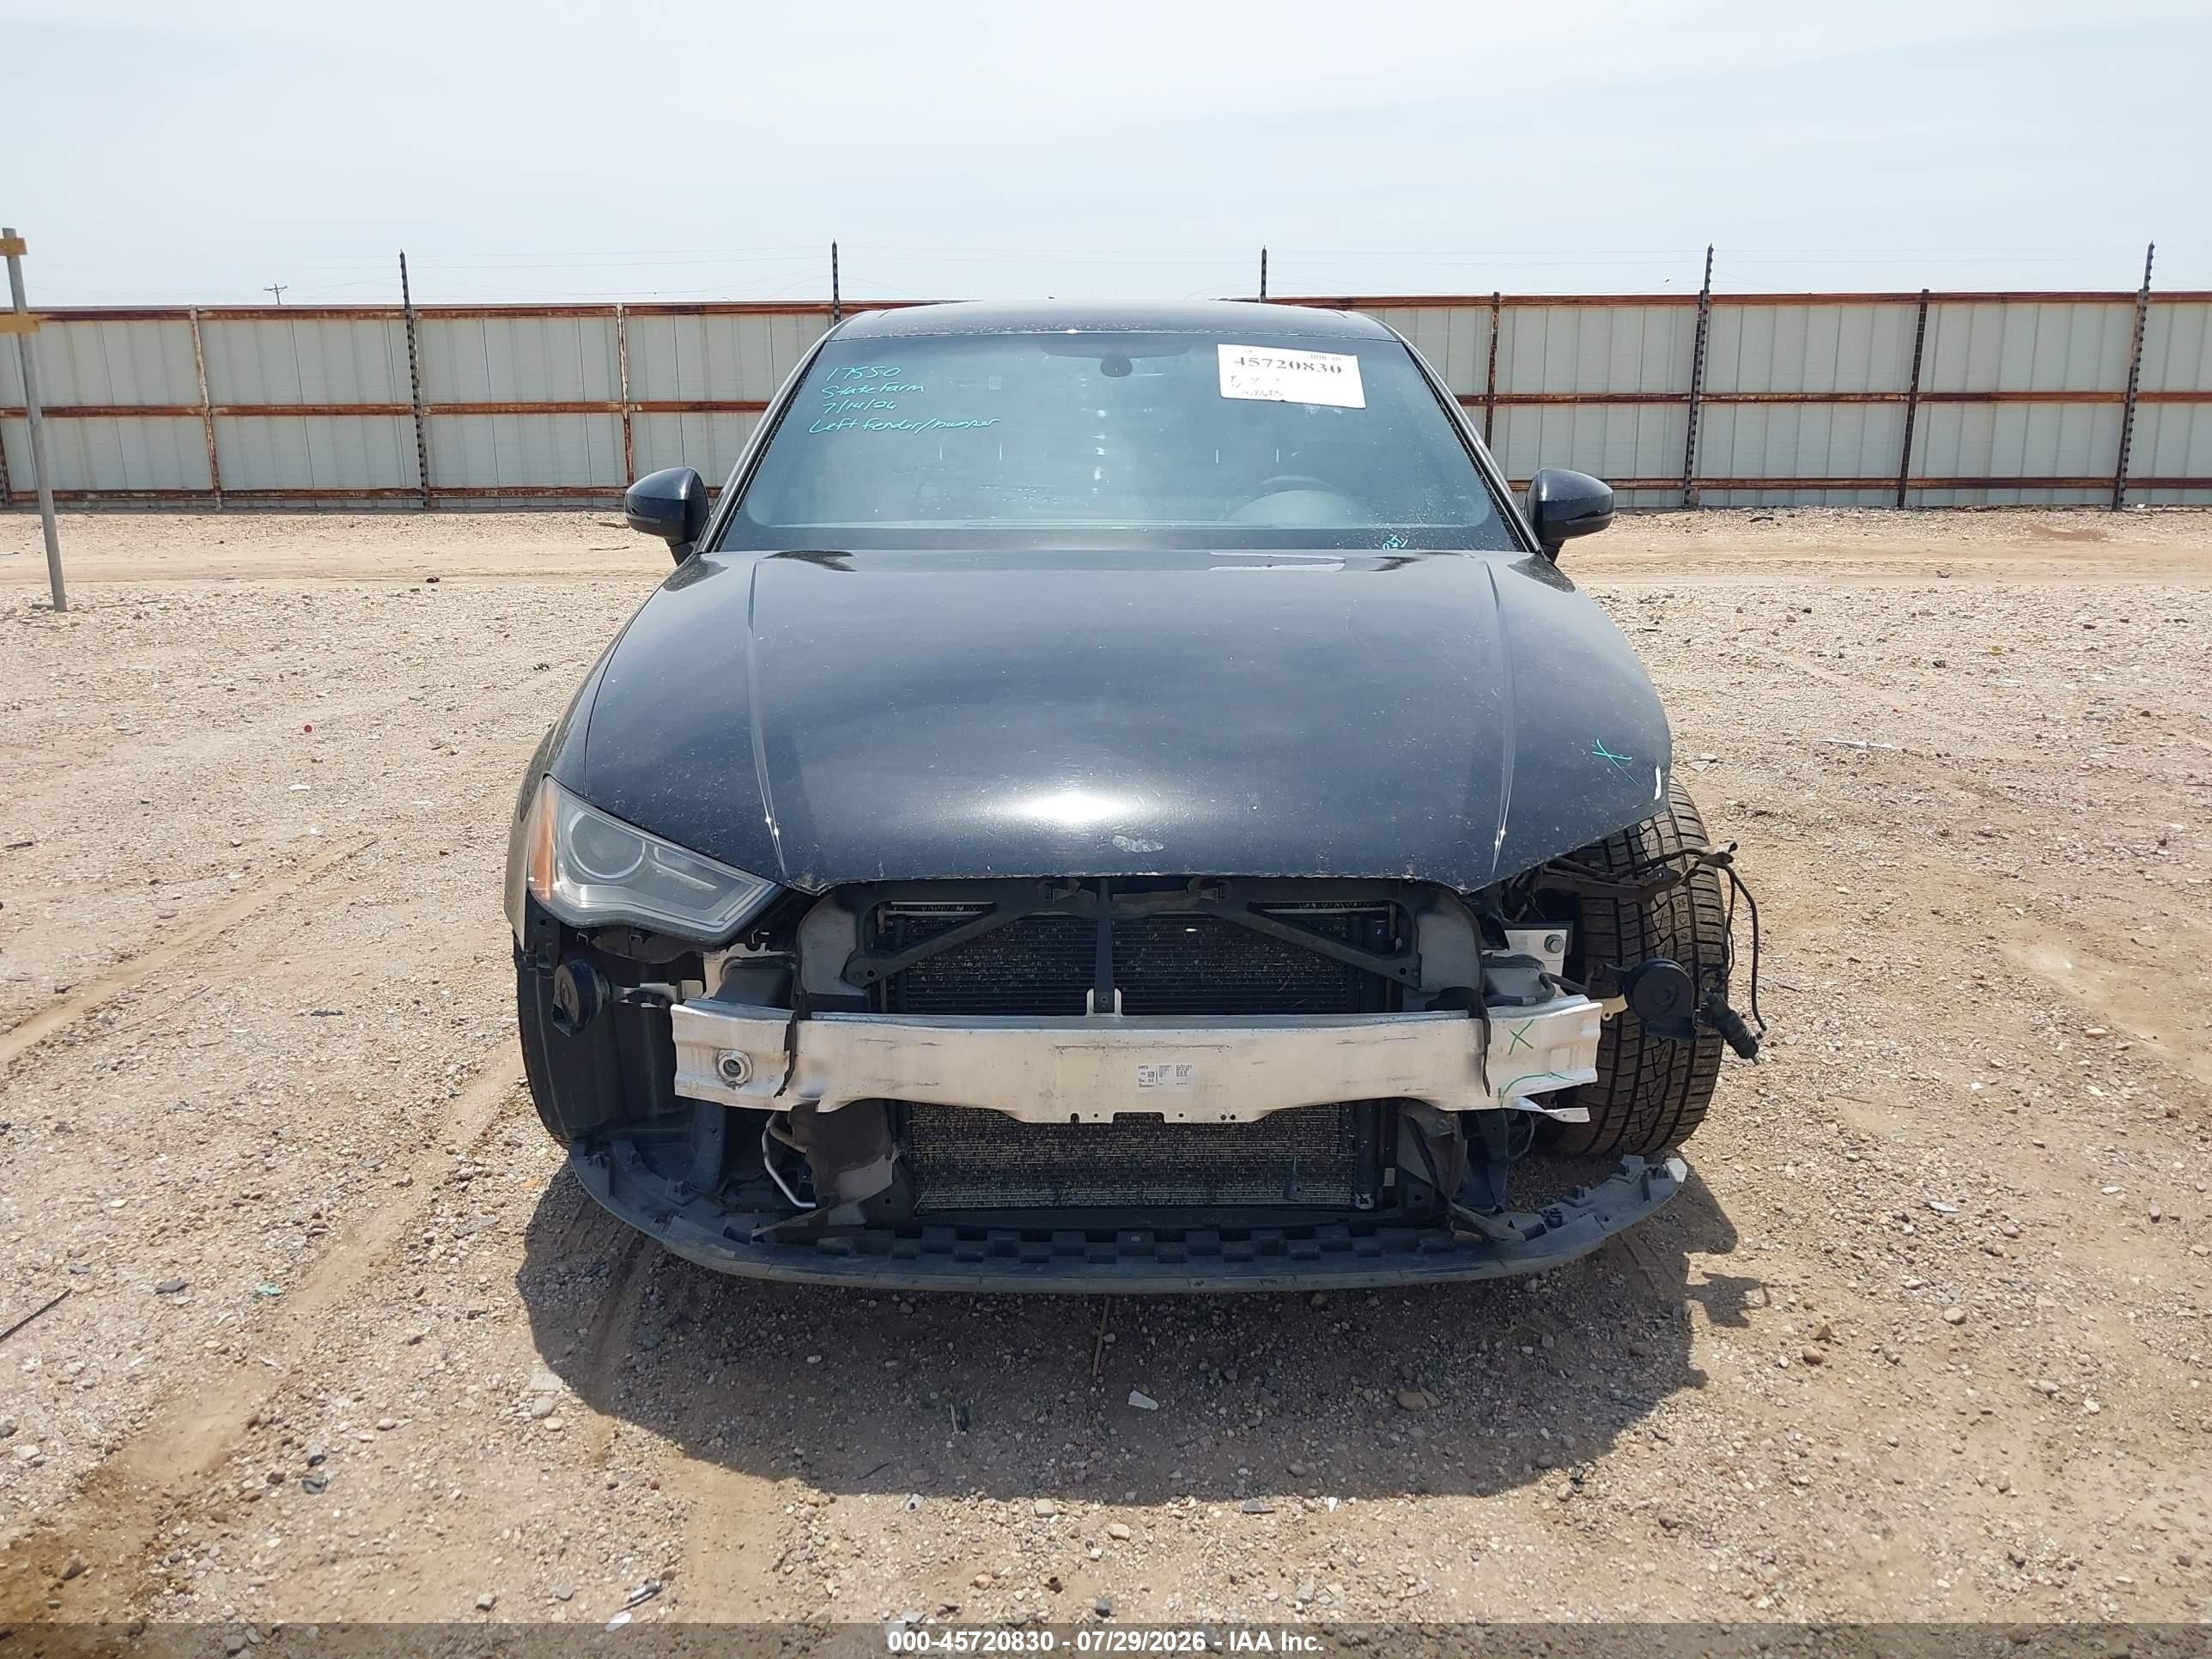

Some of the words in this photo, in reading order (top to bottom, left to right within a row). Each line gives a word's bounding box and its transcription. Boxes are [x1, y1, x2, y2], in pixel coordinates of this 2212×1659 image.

[1233, 356, 1343, 374] 45720830
[826, 366, 902, 382] 17550
[821, 386, 876, 399] State
[878, 381, 925, 393] Farm
[822, 398, 898, 414] 7/14/26
[809, 417, 858, 434] Left
